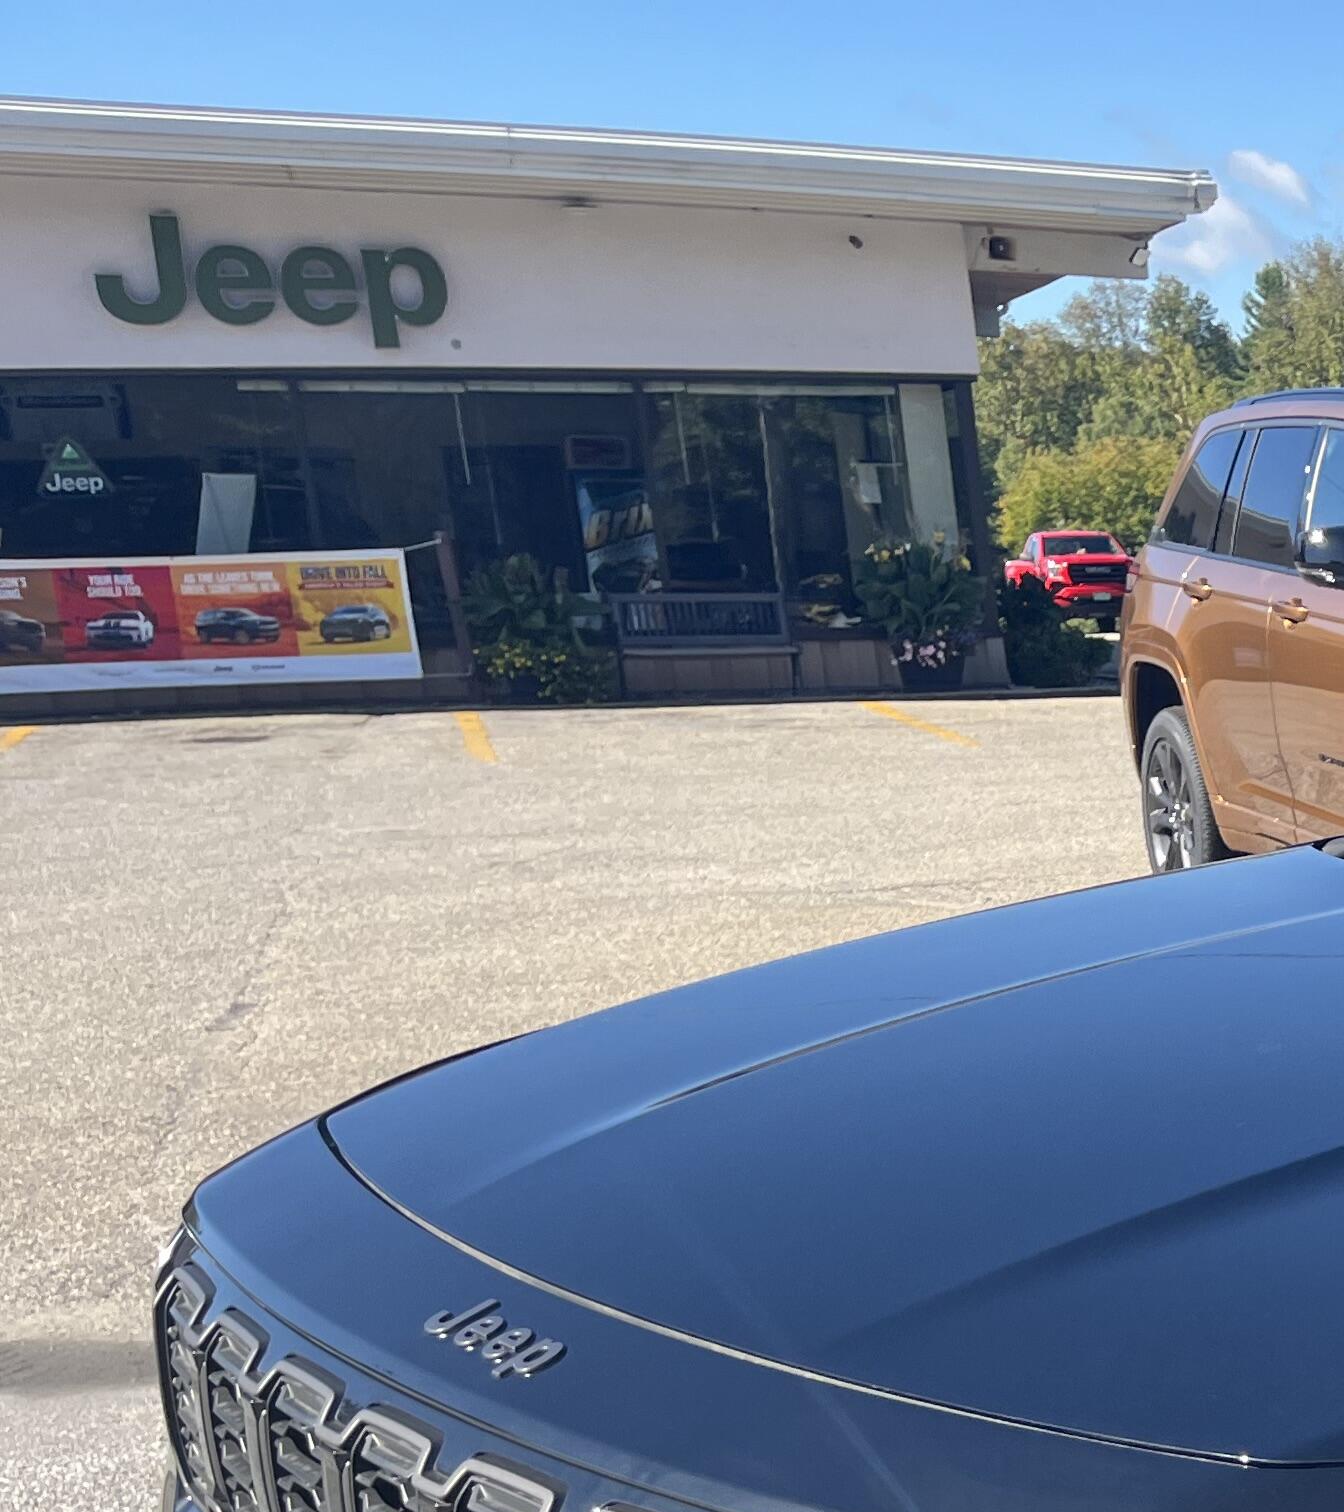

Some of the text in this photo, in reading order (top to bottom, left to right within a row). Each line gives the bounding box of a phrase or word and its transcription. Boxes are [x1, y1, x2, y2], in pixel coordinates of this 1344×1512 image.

[94, 214, 449, 349] Jeep
[45, 472, 104, 494] Jeep
[423, 1298, 566, 1379] Jeep
